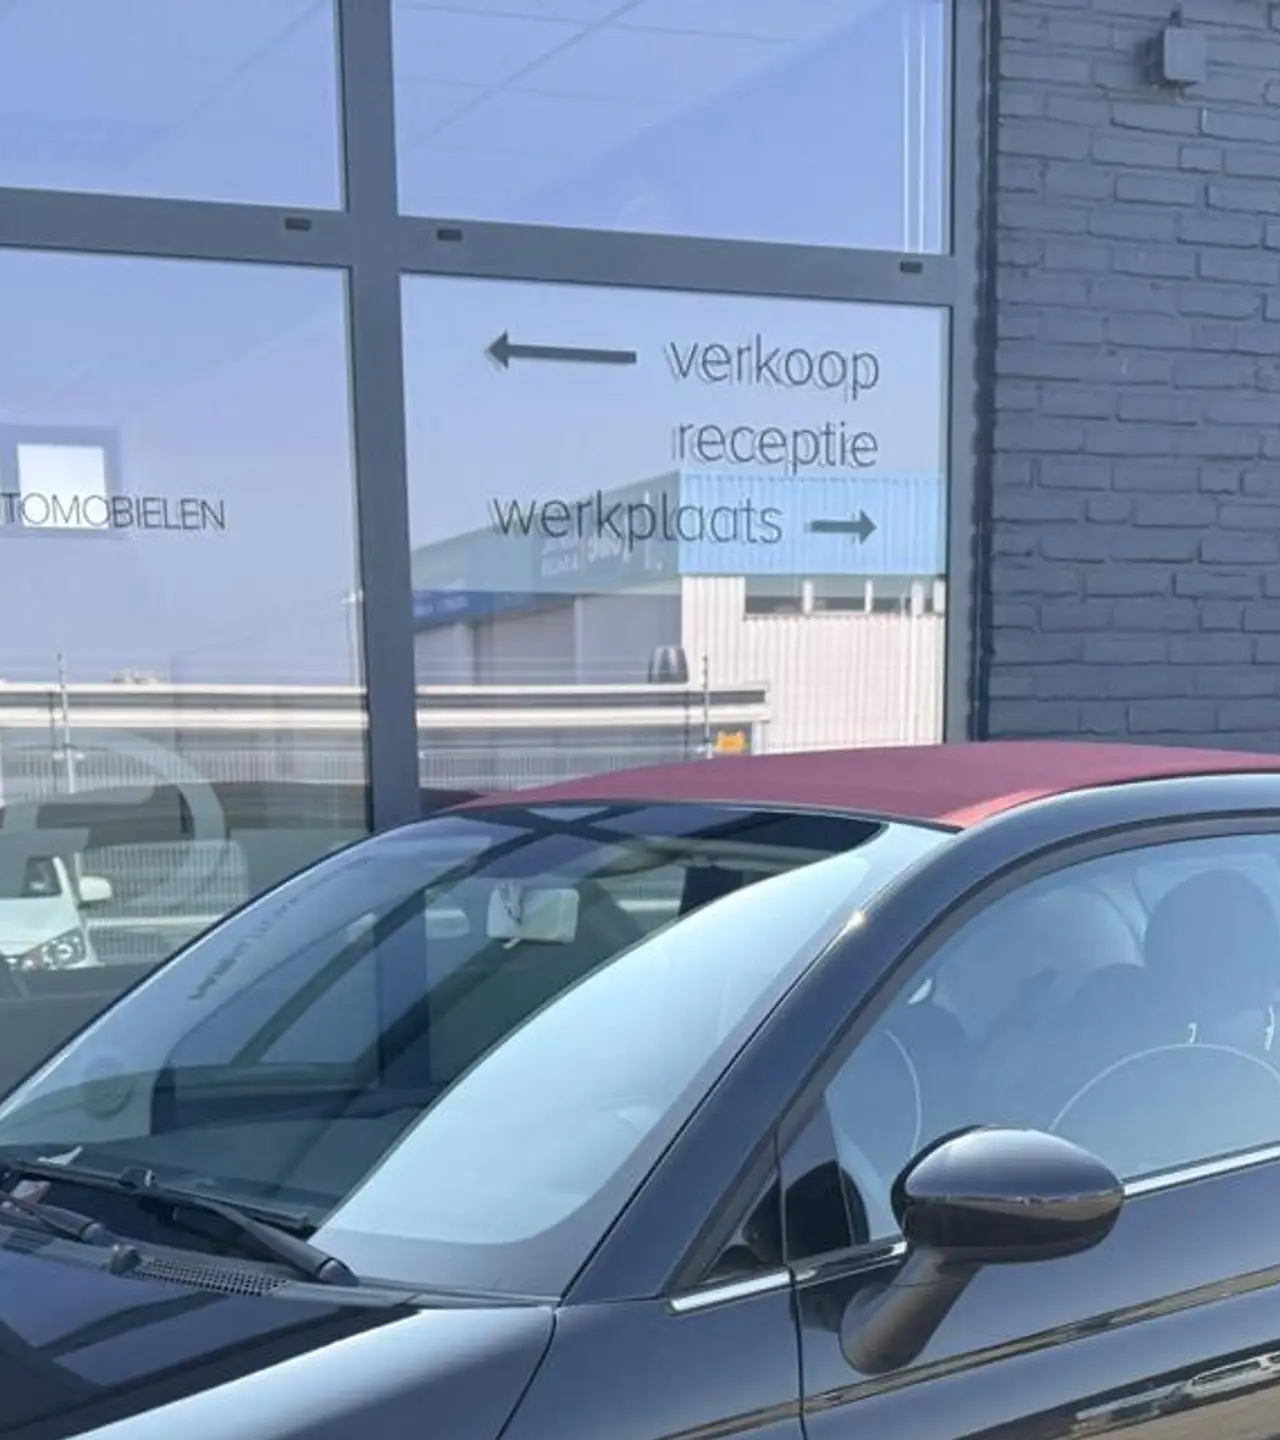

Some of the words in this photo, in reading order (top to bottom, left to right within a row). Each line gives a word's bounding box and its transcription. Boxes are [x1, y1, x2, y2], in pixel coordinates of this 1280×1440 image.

[667, 334, 880, 401] verkoop
[674, 421, 879, 475] receptie
[490, 490, 784, 552] werkplaats
